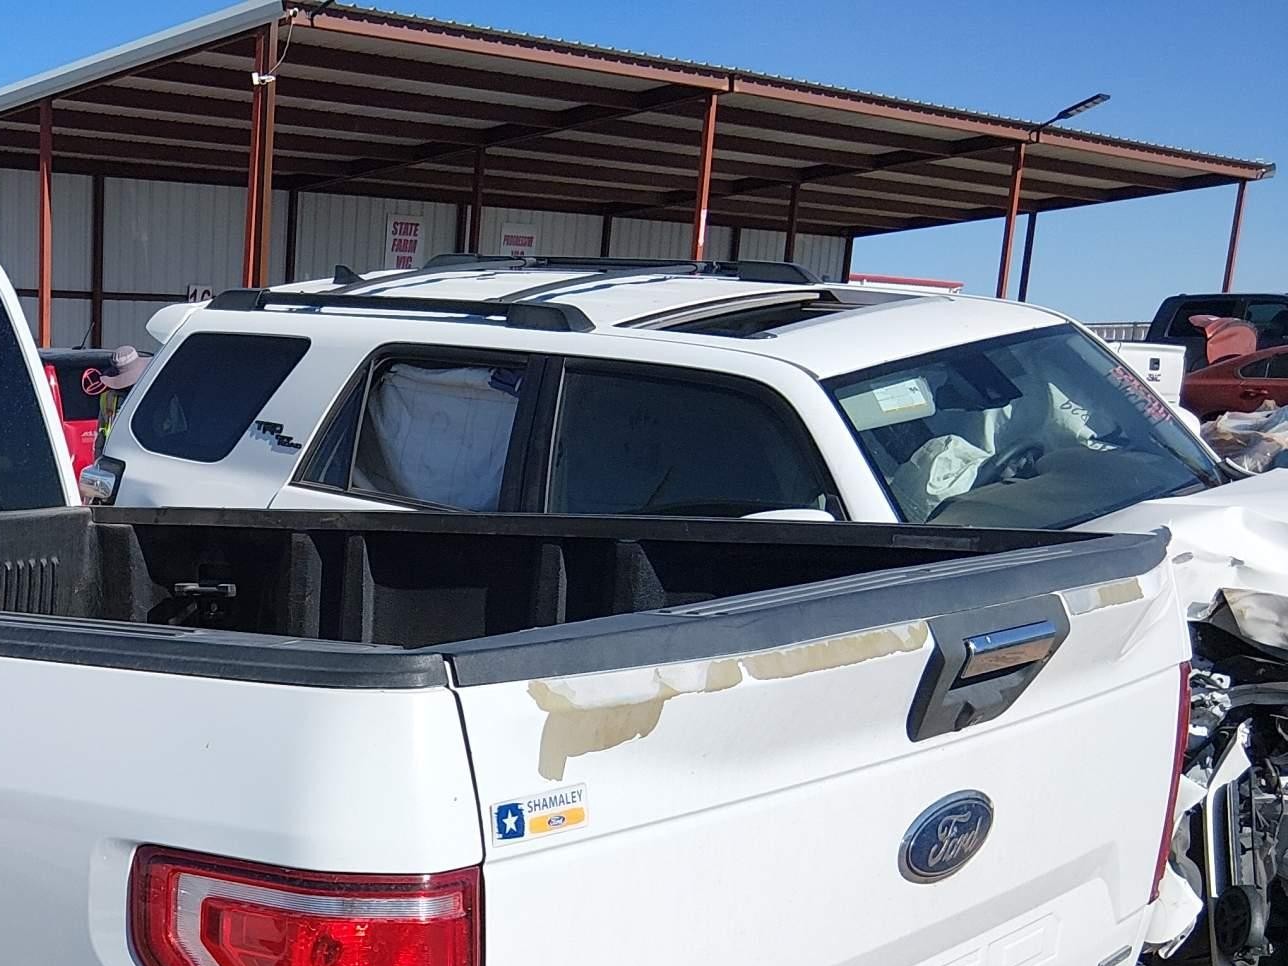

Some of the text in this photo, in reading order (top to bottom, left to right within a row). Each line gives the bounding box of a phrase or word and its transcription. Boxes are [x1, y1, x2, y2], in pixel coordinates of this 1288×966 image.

[391, 221, 420, 237] STATE
[391, 238, 418, 254] FARM
[395, 255, 414, 270] VIC
[527, 789, 583, 813] SHAMALEY
[927, 810, 983, 867] Ford
